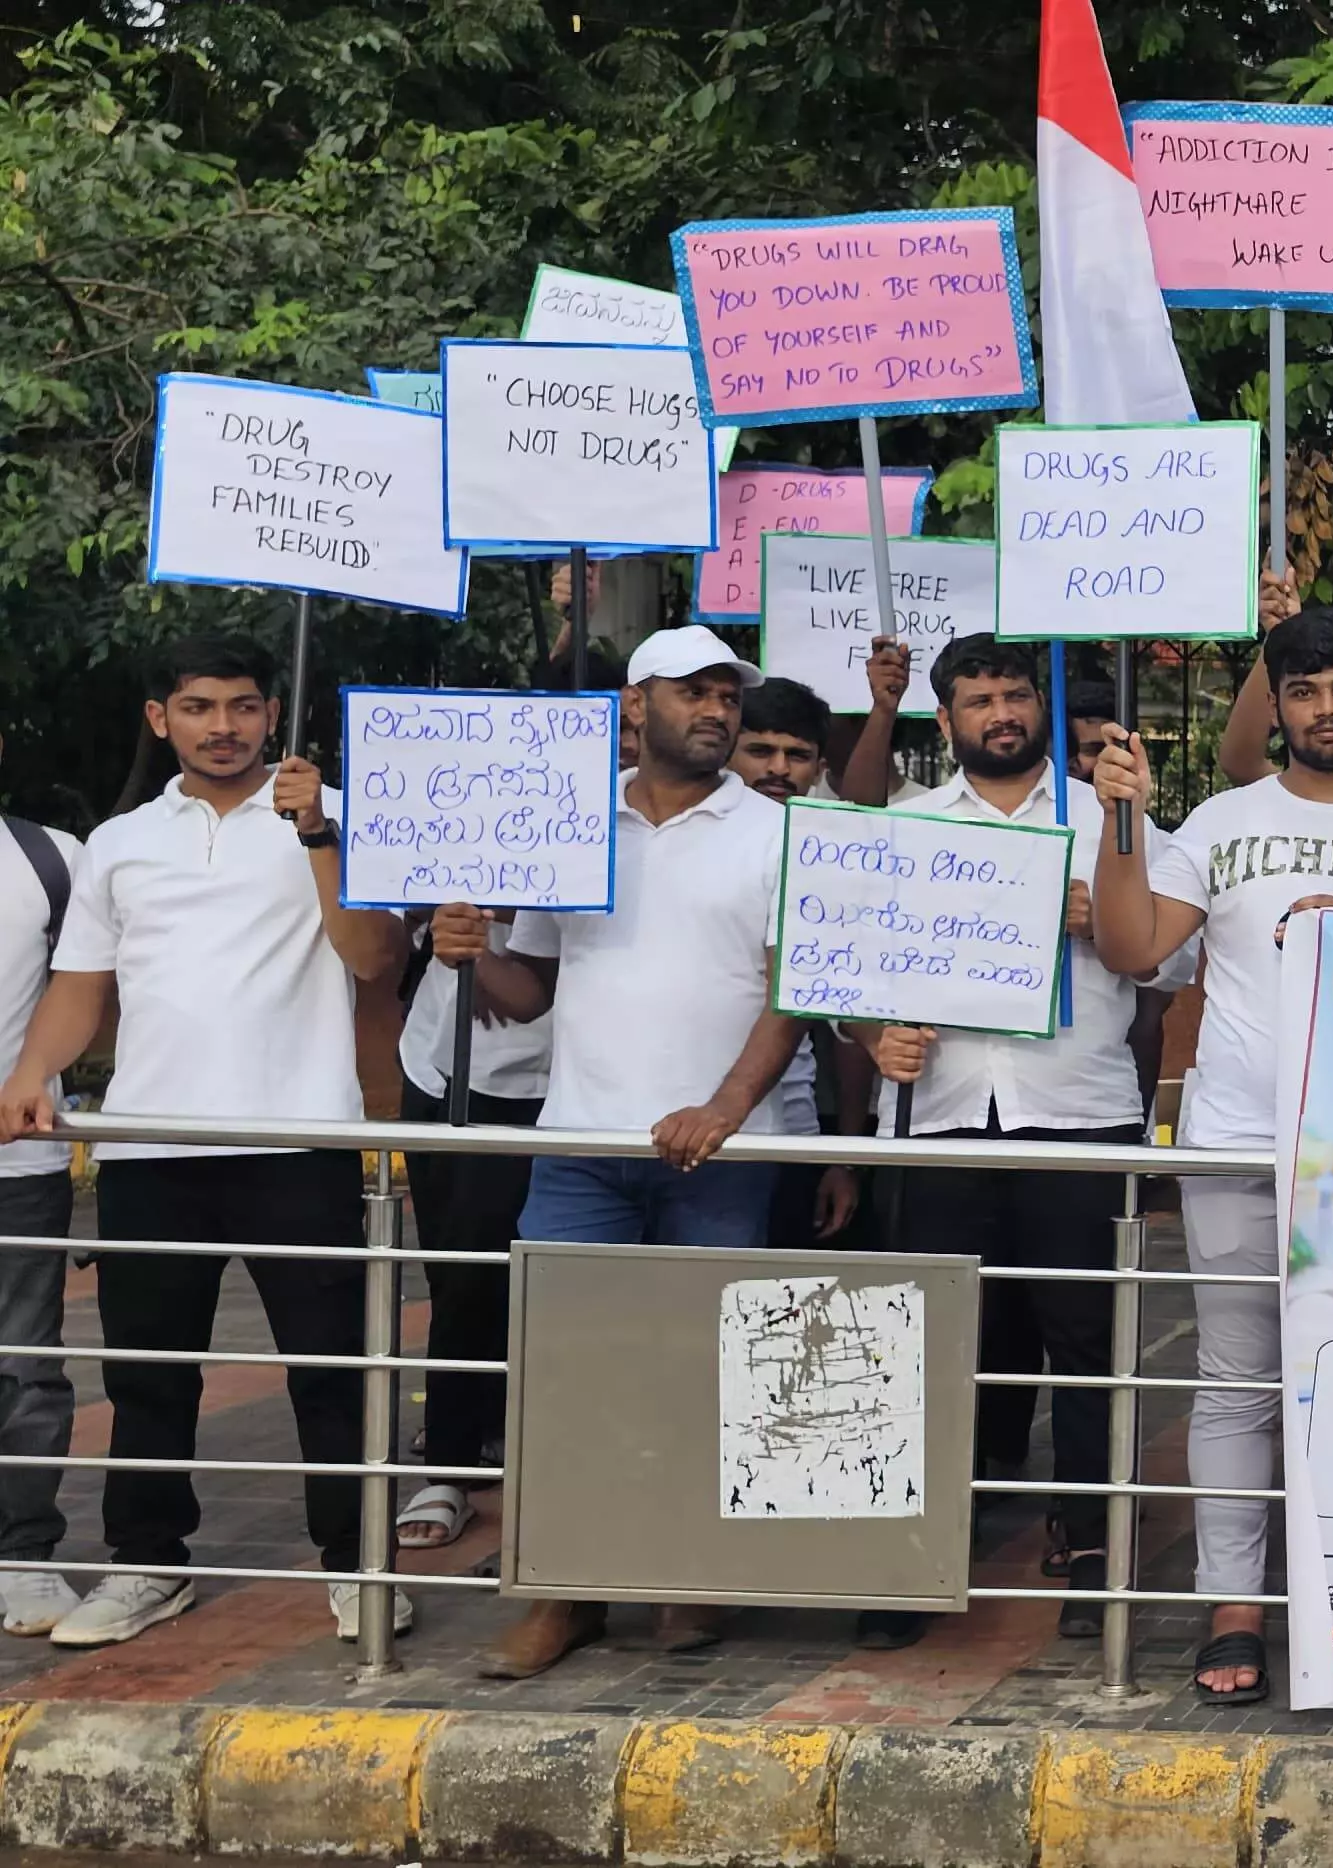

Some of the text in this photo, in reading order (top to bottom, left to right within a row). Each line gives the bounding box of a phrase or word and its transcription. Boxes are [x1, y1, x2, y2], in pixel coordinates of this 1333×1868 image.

[1140, 132, 1309, 165] "ADDICTION
[1148, 189, 1308, 220] NIGHTMARE
[693, 235, 969, 271] "DRUGS WILL DRAG
[1231, 237, 1304, 268] WAKE
[709, 287, 757, 320] YOU
[883, 277, 919, 301] BE
[929, 272, 1008, 297] PROUD
[712, 319, 951, 360] OF AND
[720, 344, 1002, 400] SAY NO TO DRUGS"
[629, 386, 699, 431] HUGS
[205, 410, 310, 456] "DRUG
[507, 428, 689, 472] NOT DRUGS"
[246, 453, 393, 498] DESTROY
[1024, 450, 1217, 487] DRUGS ARE
[211, 485, 355, 528] FAMILIES
[739, 483, 757, 504] D
[732, 516, 747, 541] E
[1019, 508, 1205, 541] DEAD AND
[728, 549, 743, 570] A
[727, 583, 741, 603] D
[798, 563, 949, 602] "LIVE FREE
[1065, 566, 1165, 600] ROAD
[810, 606, 956, 639] LIVE DRUG
[365, 763, 405, 800] ರು
[351, 813, 484, 852] ಸೇವಿಸಲು
[404, 855, 559, 904] ಸುವುದಿಲ್ಲ
[879, 946, 955, 976] ಬೇಡ
[967, 960, 1043, 990] ಎಂದು
